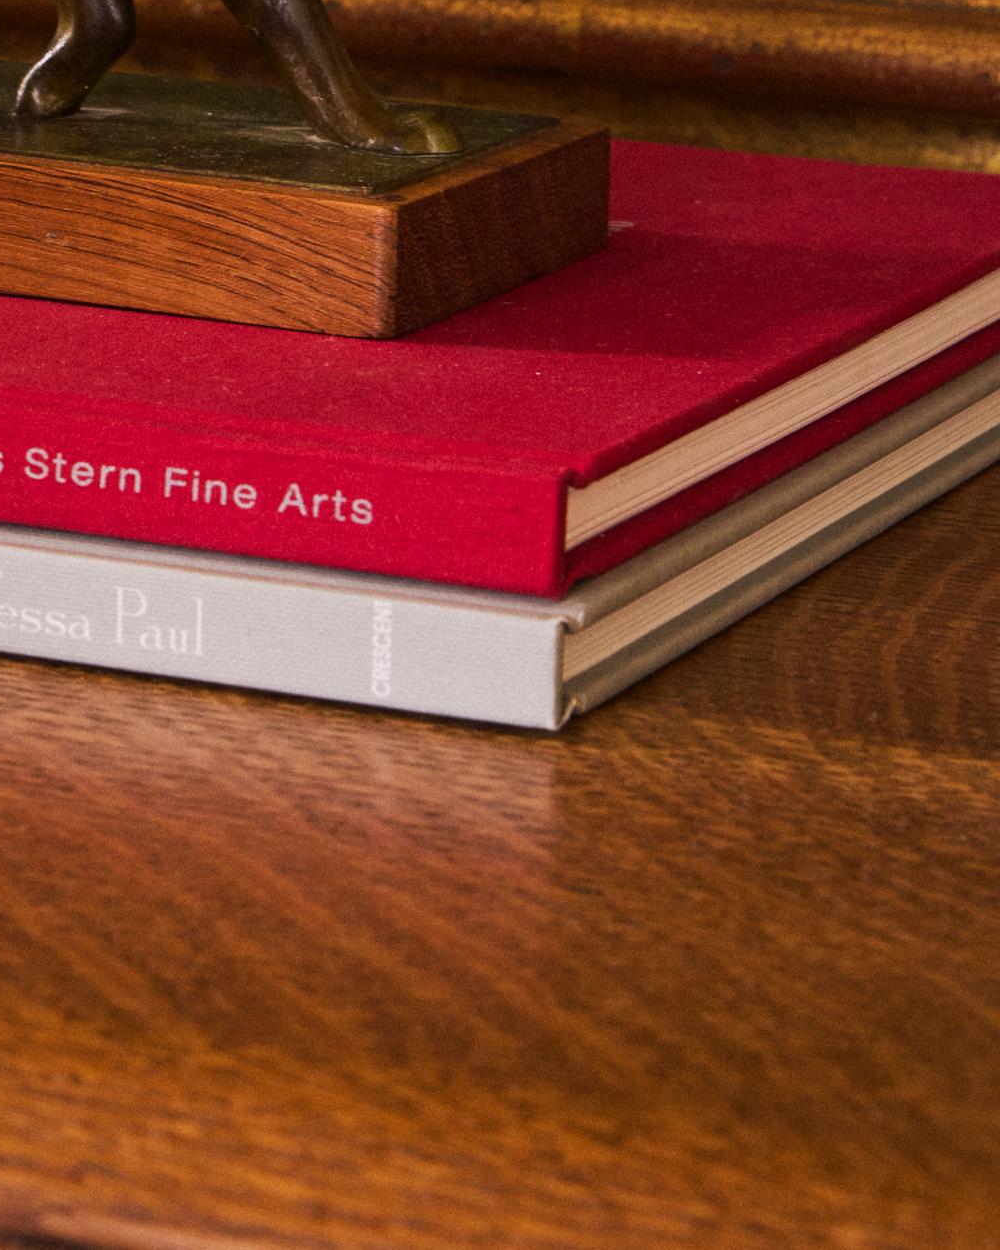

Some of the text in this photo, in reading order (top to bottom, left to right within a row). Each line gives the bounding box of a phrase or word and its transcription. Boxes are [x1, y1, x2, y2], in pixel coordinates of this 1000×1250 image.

[24, 448, 141, 494] Stern
[163, 467, 258, 510] Fine
[278, 483, 373, 525] Arts
[114, 586, 205, 656] Paul
